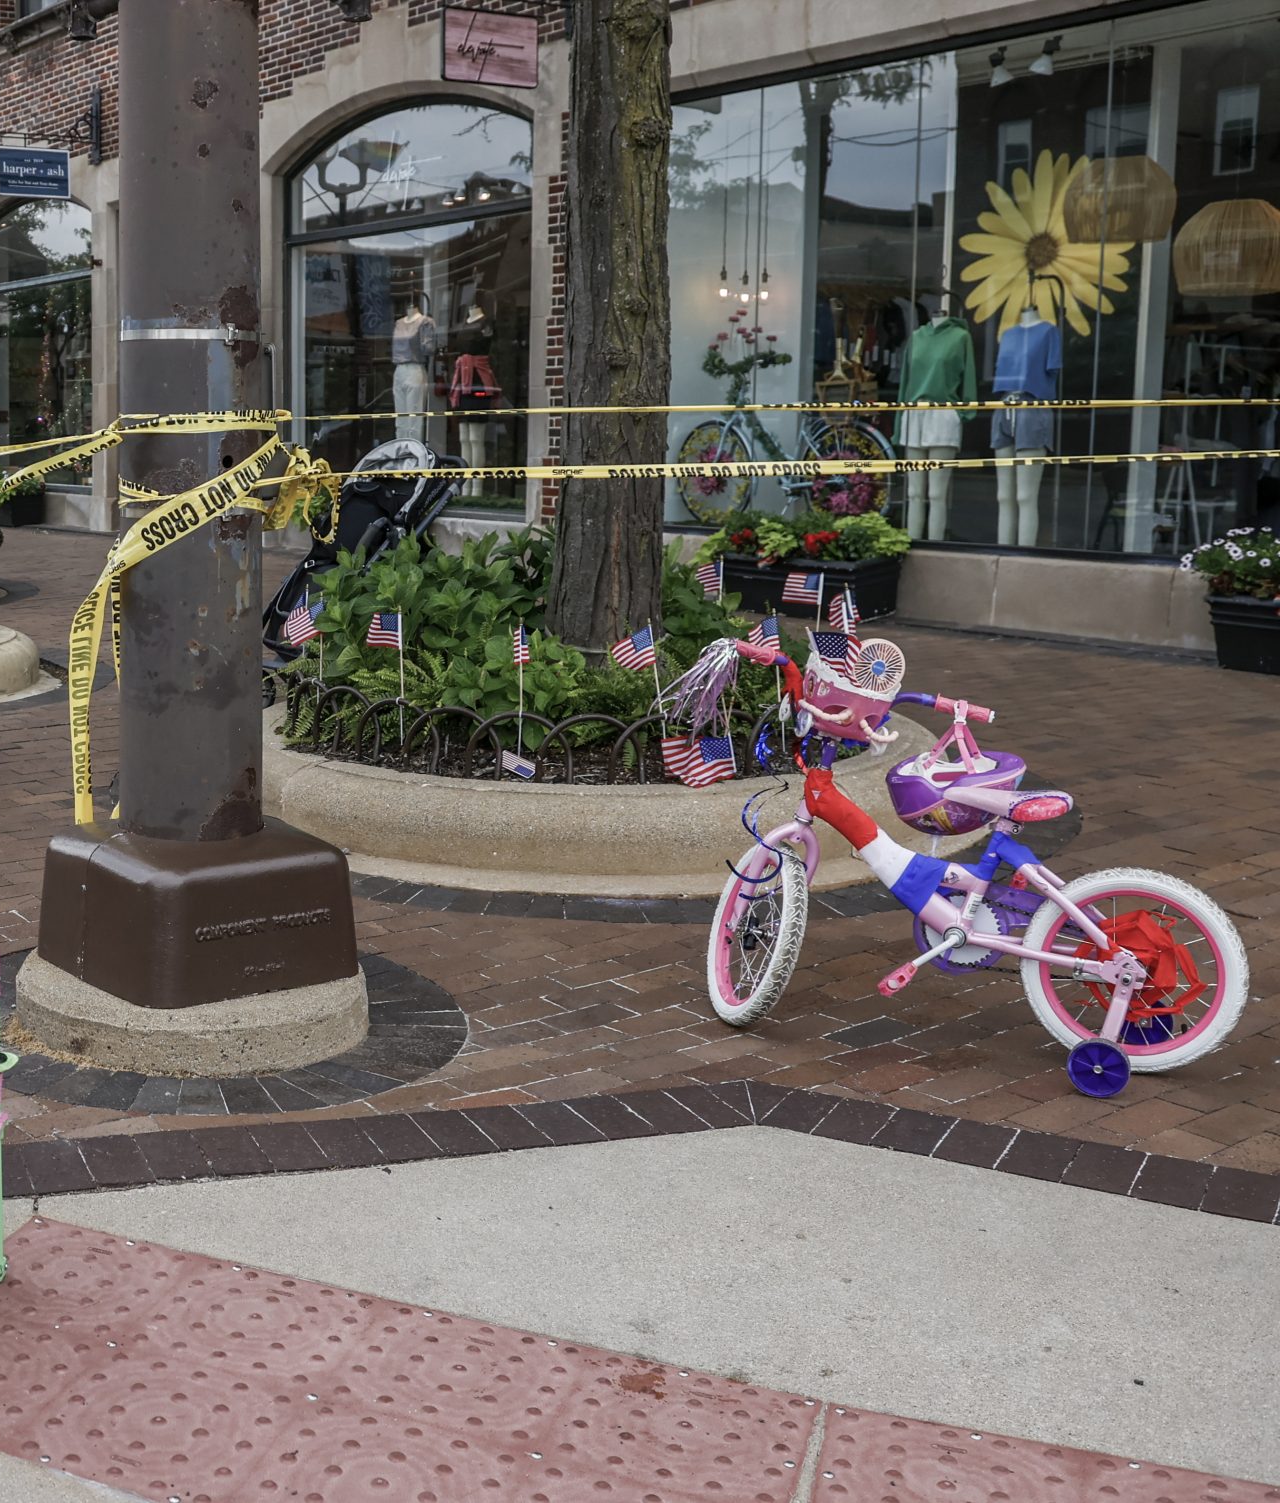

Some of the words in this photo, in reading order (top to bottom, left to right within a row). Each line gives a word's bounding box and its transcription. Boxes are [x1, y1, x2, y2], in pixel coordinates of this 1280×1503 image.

[2, 161, 37, 177] harper
[47, 164, 65, 177] ash
[552, 468, 584, 476] SIRCHIE
[608, 467, 665, 479] POLICE
[670, 466, 705, 478] LINE
[711, 465, 733, 478] DO
[737, 464, 767, 477] NOT
[771, 461, 822, 476] CROSS
[232, 471, 257, 493] DO
[198, 478, 237, 518] NOT
[140, 502, 200, 551] CROSS
[195, 917, 267, 942] COMPONENT
[272, 908, 332, 931] PRODUCTS
